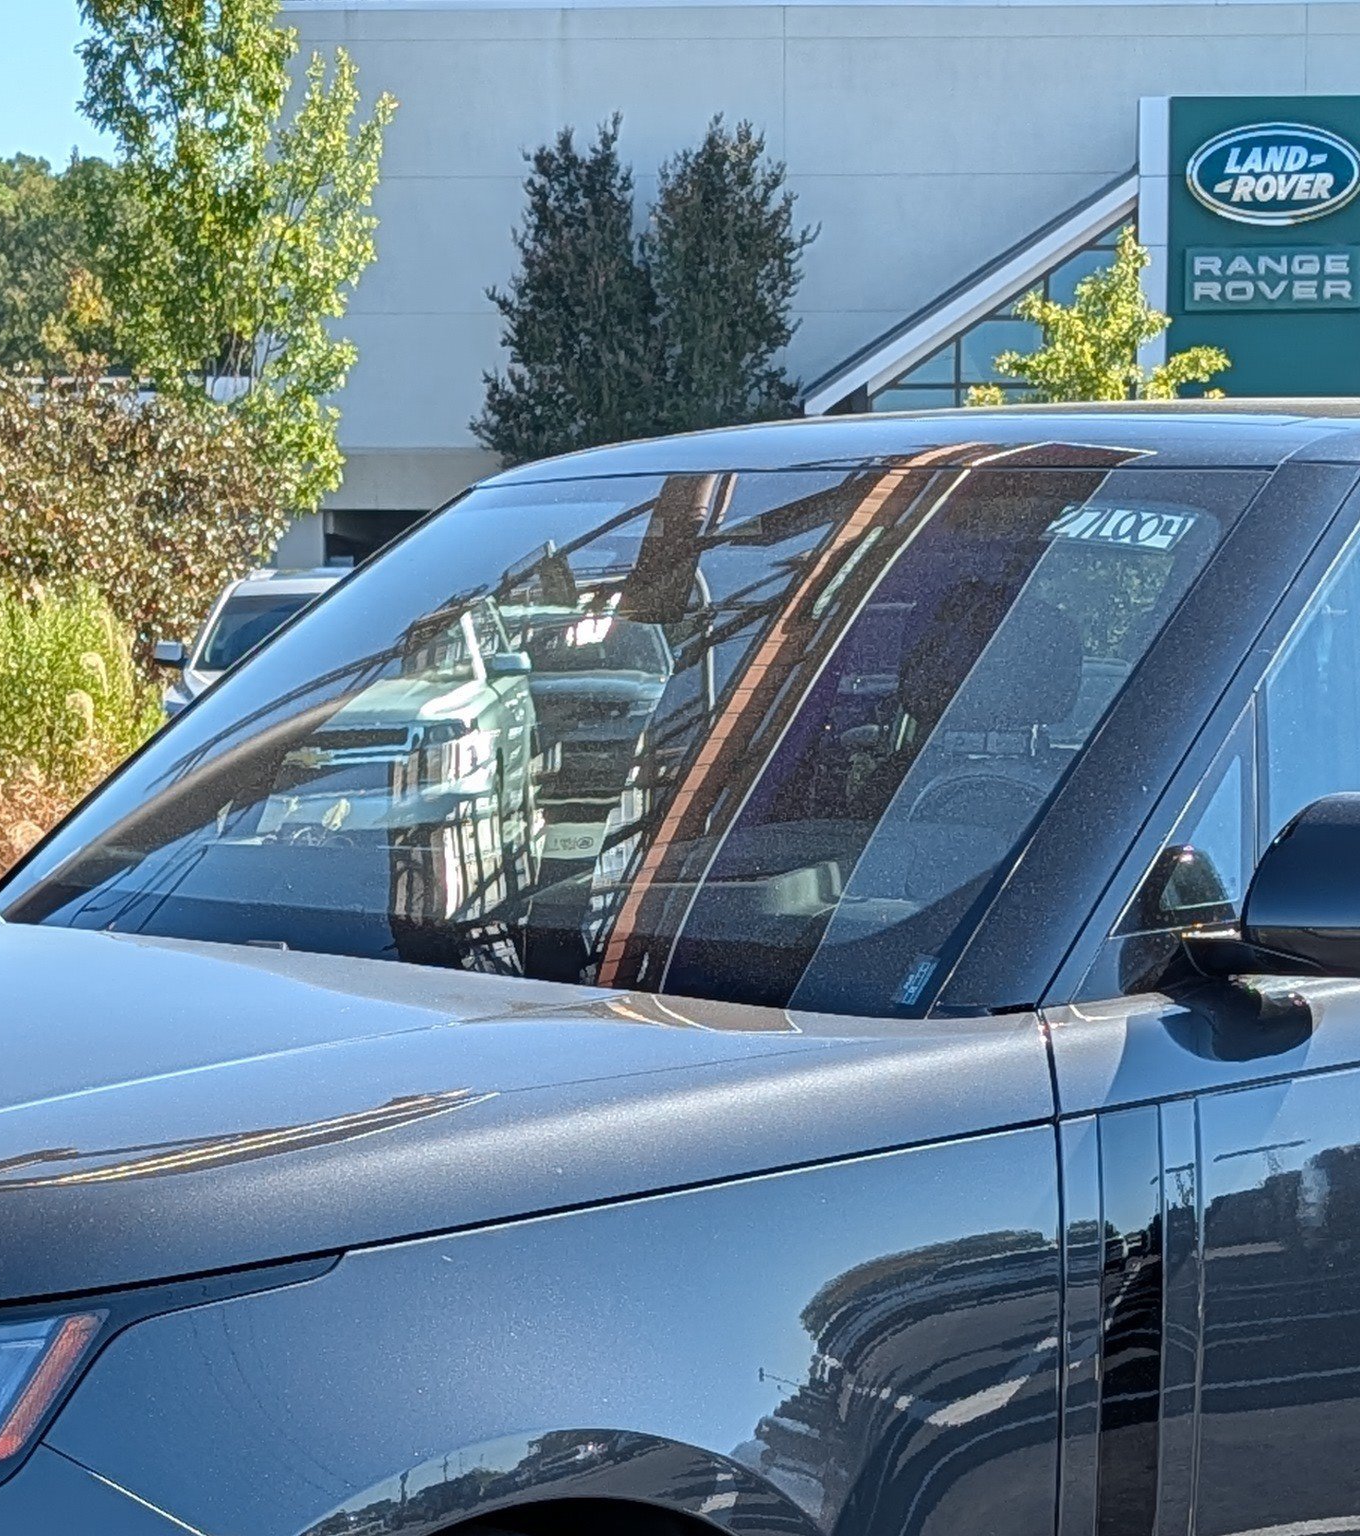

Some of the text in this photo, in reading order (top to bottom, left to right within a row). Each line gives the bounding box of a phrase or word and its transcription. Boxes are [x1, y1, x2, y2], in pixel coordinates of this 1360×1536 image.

[1224, 146, 1309, 173] LAND
[1231, 173, 1334, 201] ROVER
[1194, 254, 1350, 275] RANGE
[1194, 279, 1352, 301] ROVER
